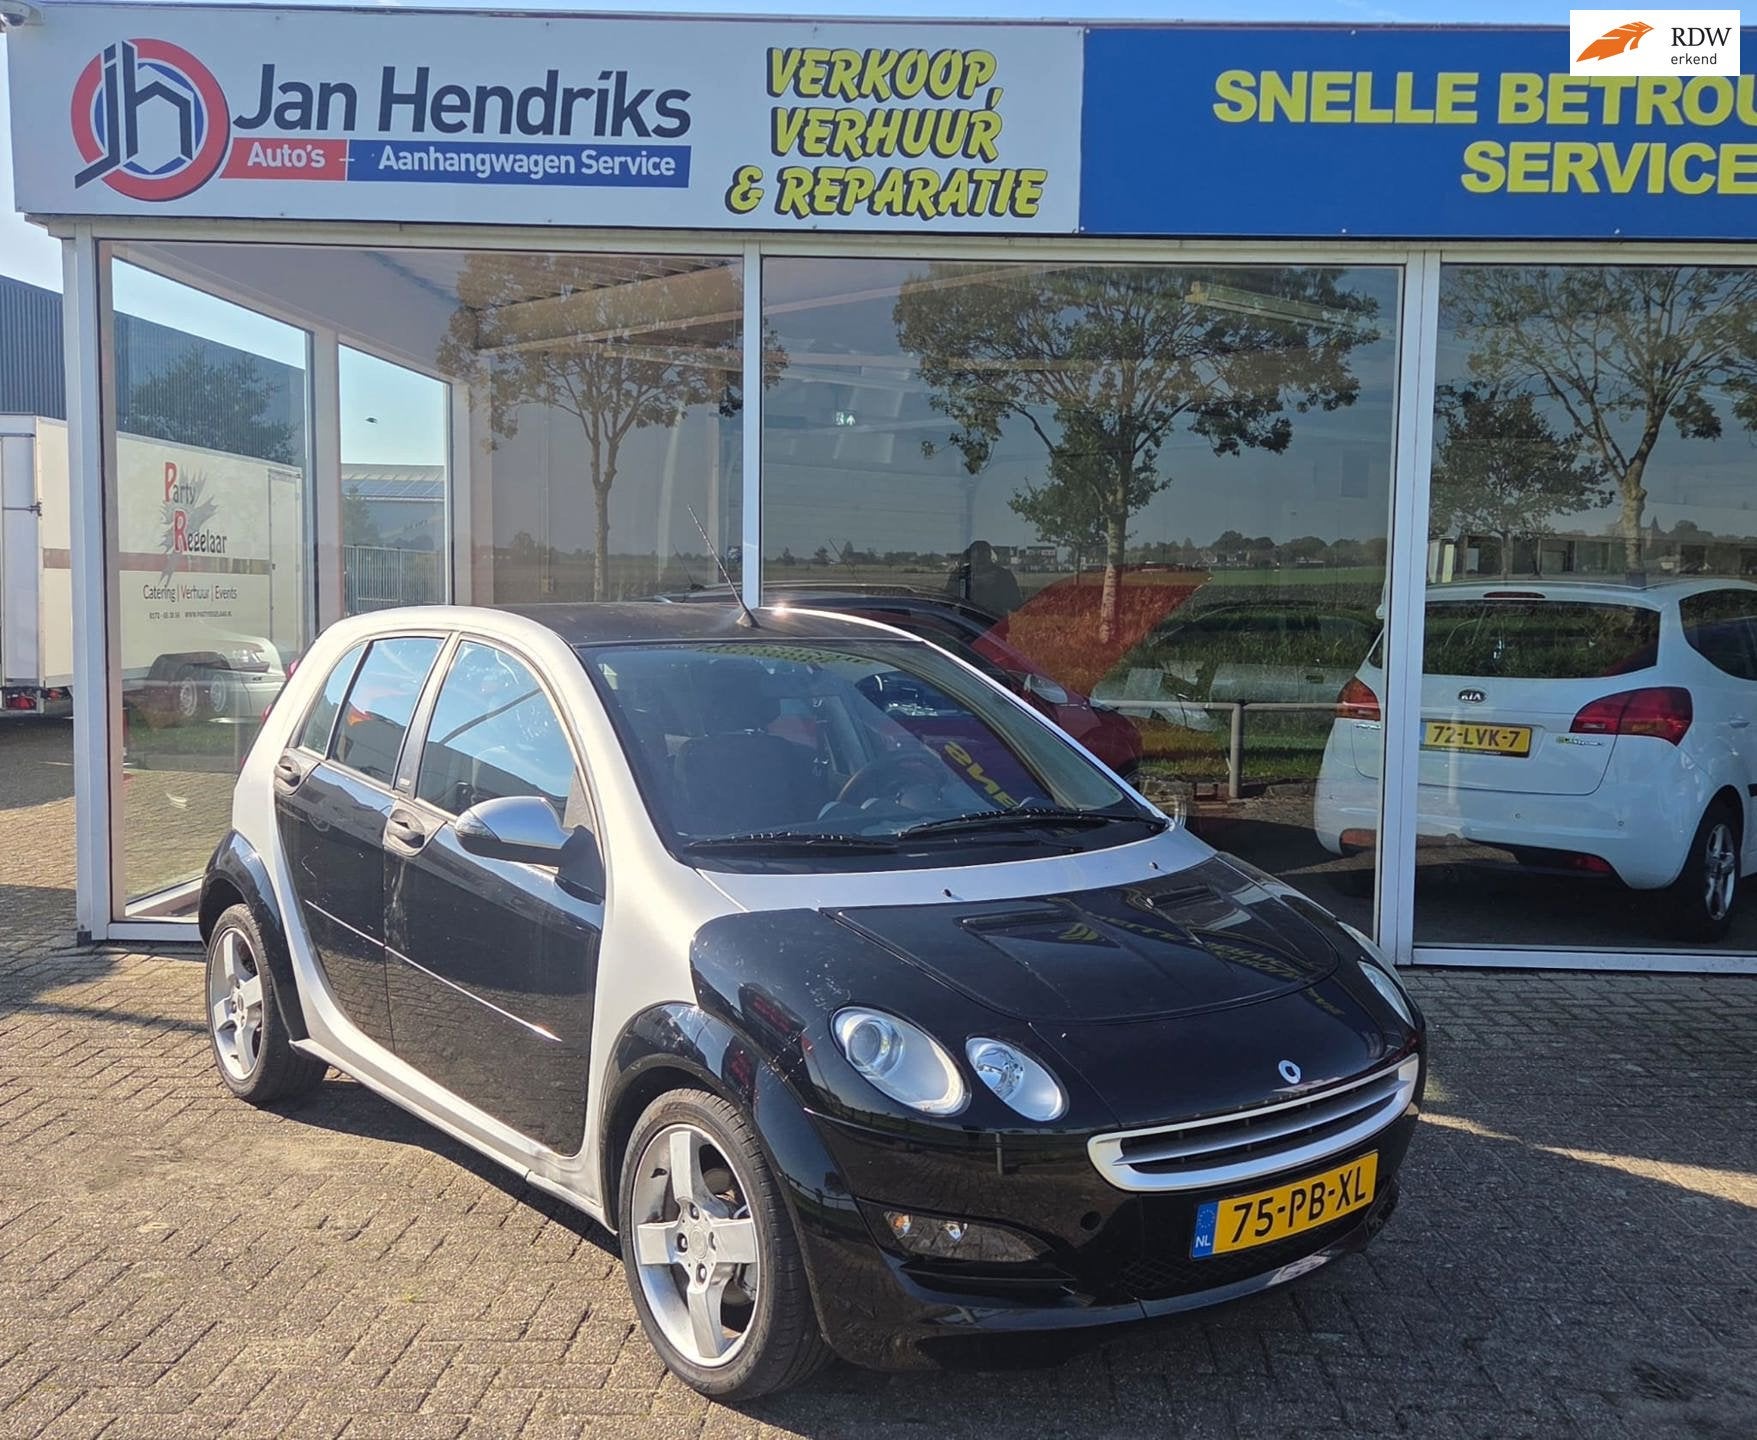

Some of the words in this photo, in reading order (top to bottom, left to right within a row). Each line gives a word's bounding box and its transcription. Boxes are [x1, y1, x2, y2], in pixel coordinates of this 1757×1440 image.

[232, 64, 357, 131] Jan
[767, 47, 1004, 109] VERKOOP,
[1212, 70, 1479, 123] SNELLE
[247, 142, 326, 168] Auto's
[378, 145, 576, 179] Aanhangwagen
[581, 149, 676, 176] Service
[771, 106, 1003, 163] VERHUUR
[725, 164, 764, 214] &
[776, 166, 1048, 221] REPARATIE
[1460, 141, 1757, 194] SERVICE
[164, 461, 195, 503] Party
[173, 510, 228, 554] Regelaar
[143, 584, 176, 602] Catering
[180, 586, 210, 600] Verhuur
[215, 585, 238, 600] Events
[1433, 725, 1521, 748] 72-LVK-7
[1231, 1166, 1366, 1243] 75-PB-XL
[1195, 1235, 1212, 1248] NL
